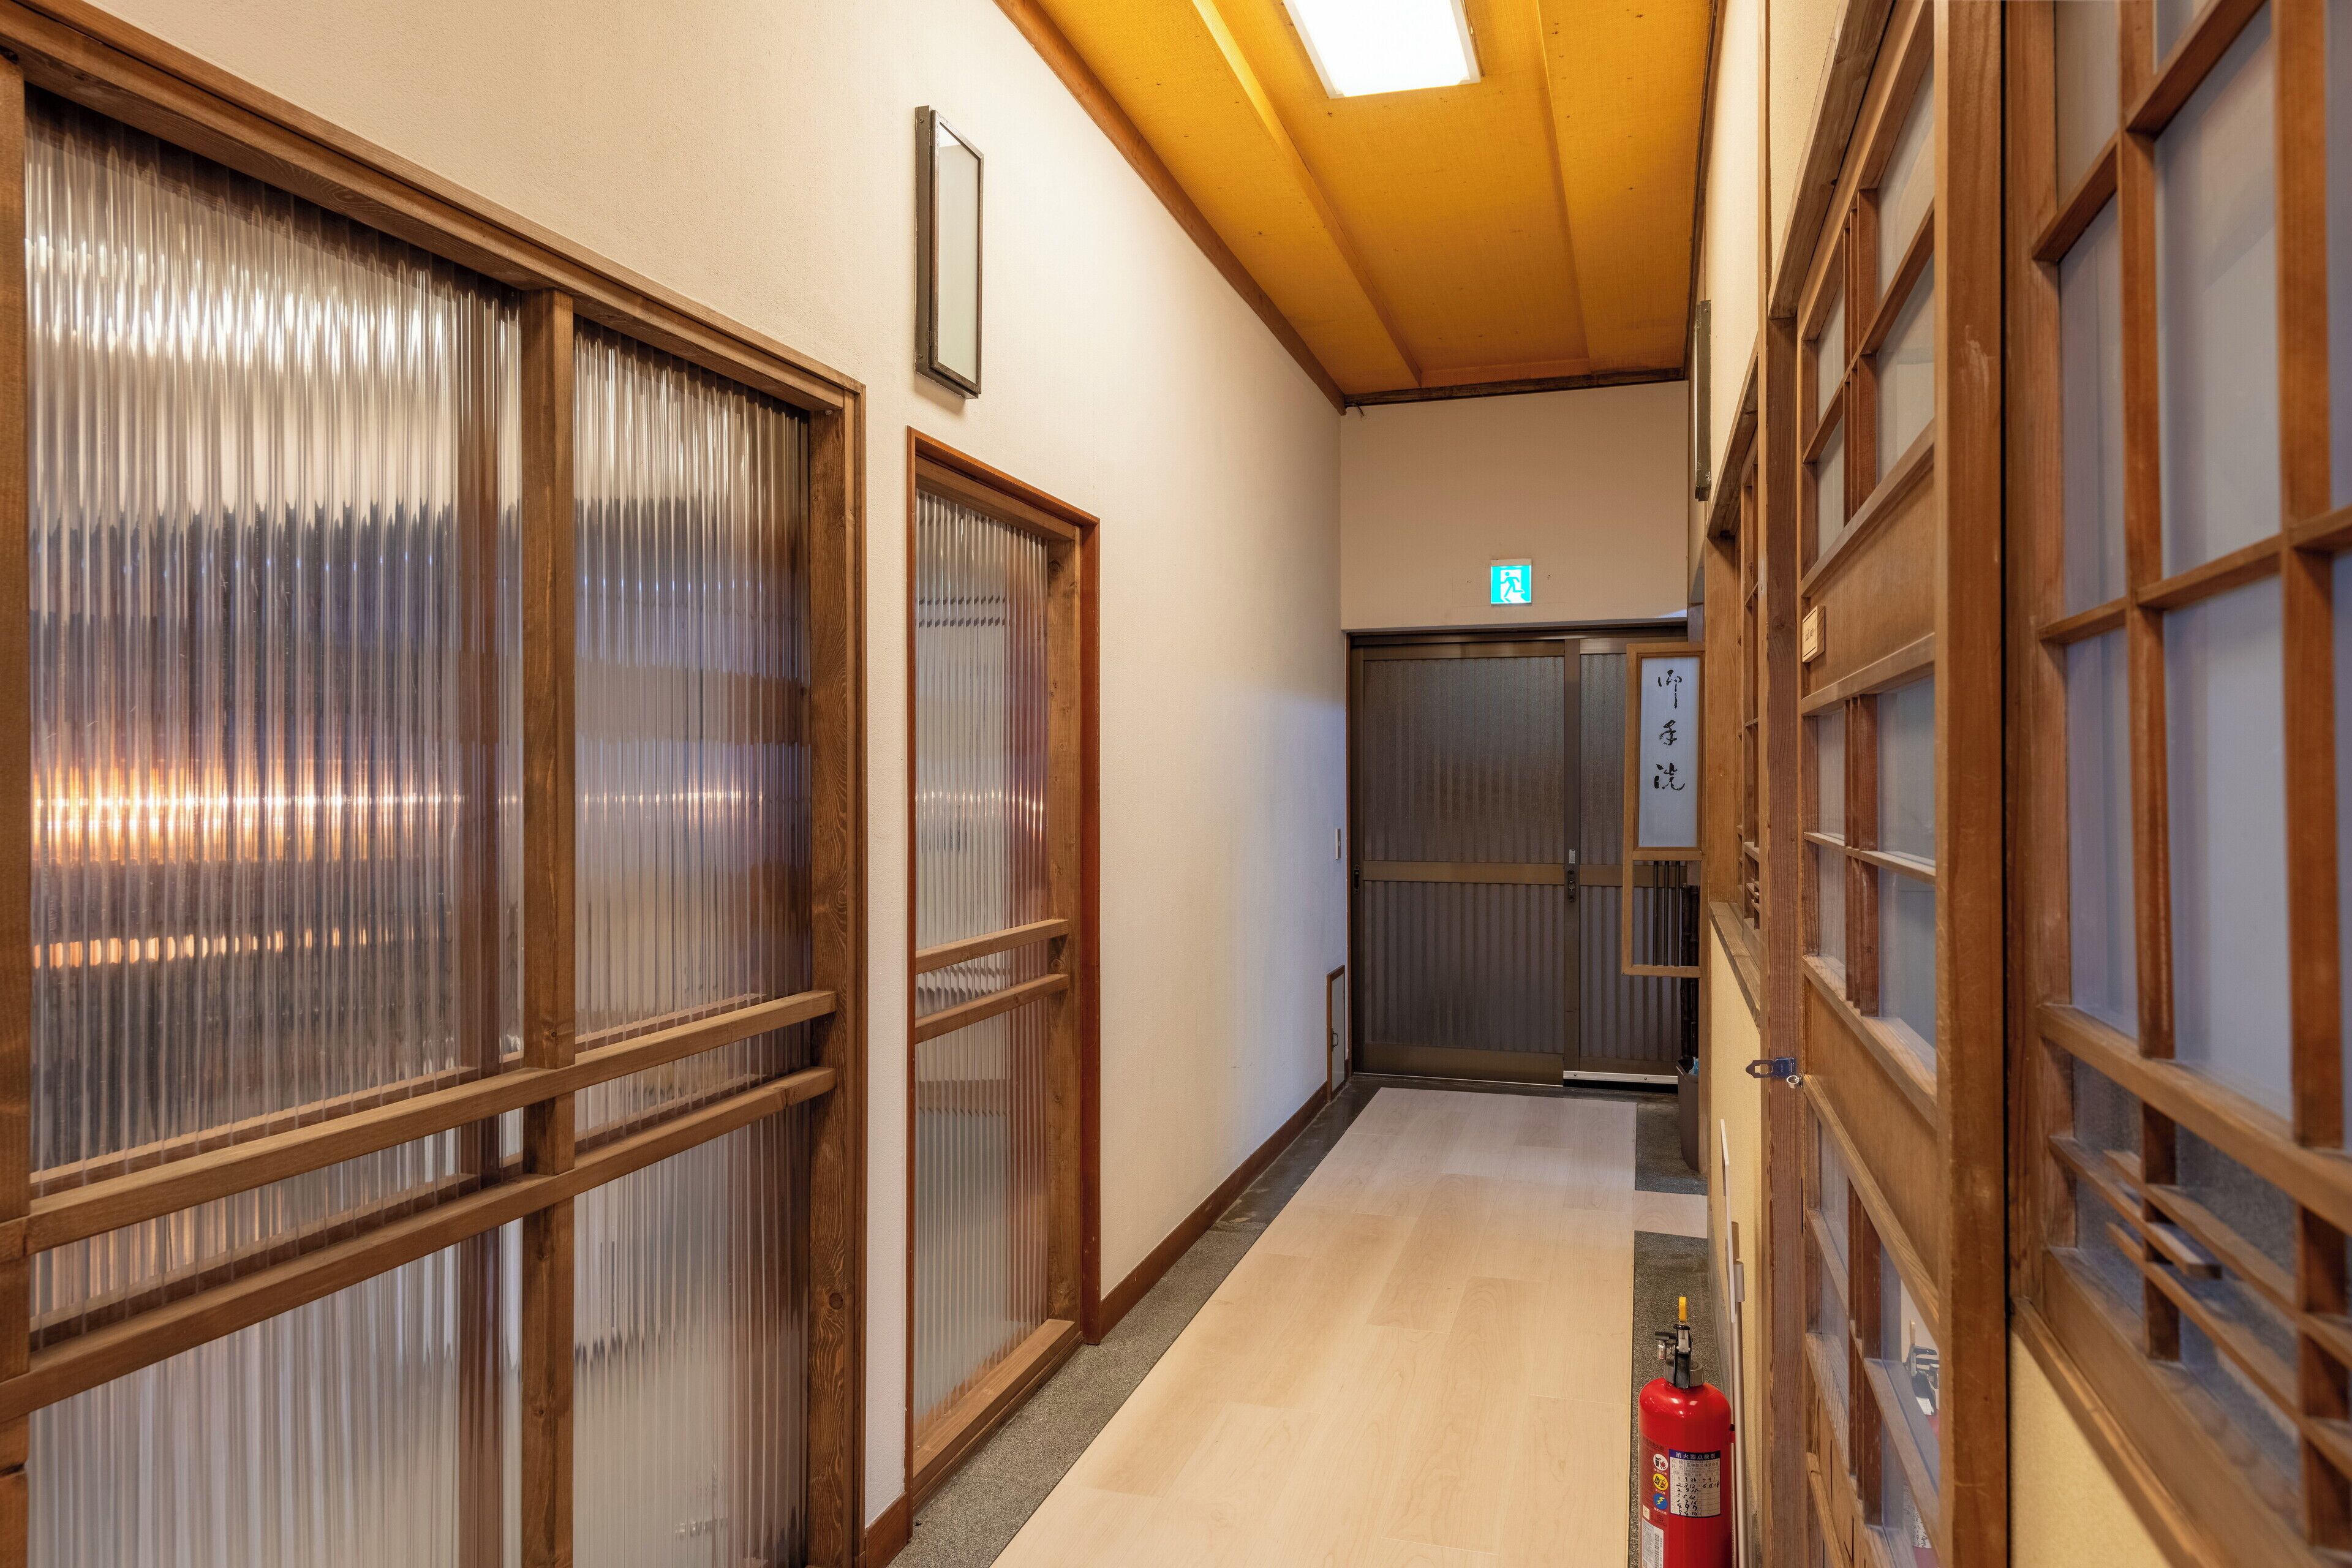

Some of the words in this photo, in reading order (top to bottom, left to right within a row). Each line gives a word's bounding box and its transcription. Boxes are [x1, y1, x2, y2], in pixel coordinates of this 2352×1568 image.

[1653, 669, 1686, 791] 御手洗
[1675, 1452, 1716, 1460] 消火器点検票
